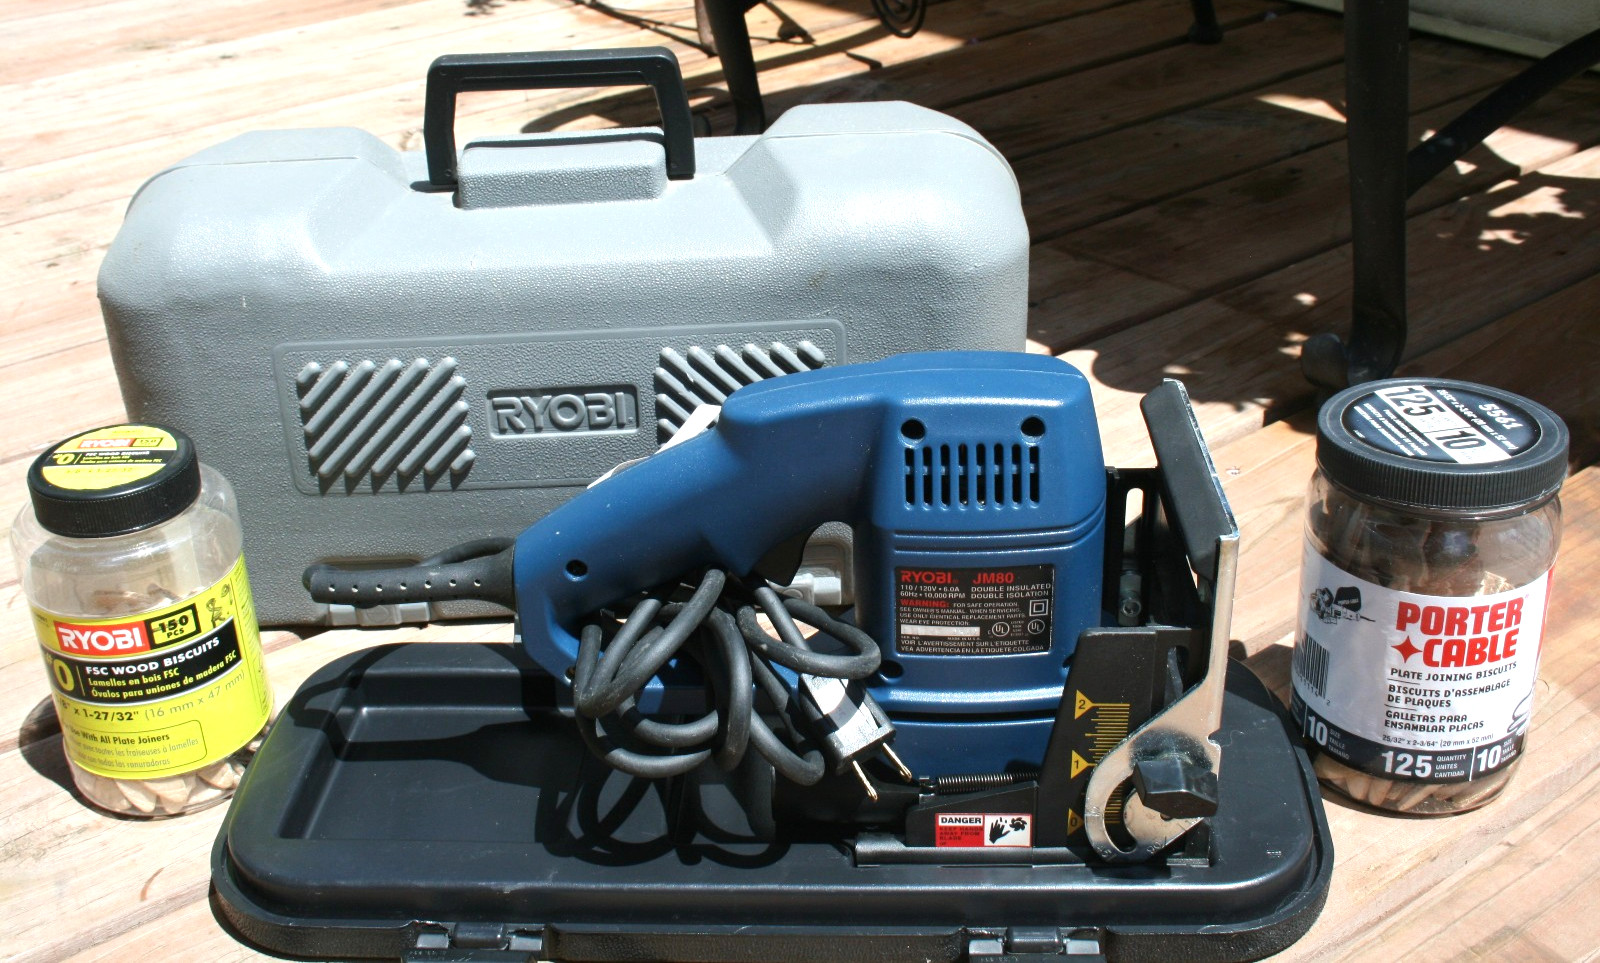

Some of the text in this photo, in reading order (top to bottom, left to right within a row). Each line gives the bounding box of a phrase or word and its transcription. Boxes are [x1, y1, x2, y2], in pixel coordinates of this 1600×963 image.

[1384, 388, 1446, 416] 125
[492, 392, 627, 433] RYOBI
[1478, 404, 1523, 429] 5561
[1435, 431, 1486, 449] 10
[900, 571, 1014, 584] RYOBI JM80
[1006, 583, 1052, 592] INSULATED
[1006, 590, 1049, 598] ISOLATION
[900, 599, 950, 608] WARNING:
[159, 614, 189, 633] 150
[1396, 597, 1524, 636] PORTER
[58, 627, 143, 651] RYOBI
[166, 628, 185, 638] PCS
[85, 636, 220, 676] FSC WOOD BISCUITS
[1422, 628, 1520, 668] CABLE
[88, 668, 180, 687] Lamelles en bois FSC
[92, 650, 237, 700] Óvalos para uniones de madera FSC
[1390, 661, 1517, 682] PLATE JOINING BISCUITS
[83, 708, 138, 722] 1-27/32"
[144, 707, 164, 720] (16
[170, 701, 194, 714] mm
[208, 686, 220, 699] 47
[224, 671, 245, 691] mm)
[1388, 679, 1510, 698] BISCUITS D'ASSEMBLAGE
[1078, 700, 1086, 710] 2
[1387, 694, 1452, 708] DE PLAQUES
[1386, 710, 1468, 723] GALLETAS PARA
[1308, 716, 1328, 746] 10
[1384, 719, 1484, 733] ENSAMBLAR PLACAS
[81, 732, 98, 742] With
[100, 736, 110, 744] All
[112, 736, 135, 744] Plate
[138, 733, 170, 744] Joiners
[115, 748, 125, 756] les
[169, 738, 199, 752] lamelles
[115, 760, 126, 768] las
[126, 758, 170, 768] ranuradoras
[1074, 760, 1080, 770] 1
[1382, 750, 1433, 778] 125
[1436, 754, 1467, 762] QUANTITY
[1477, 744, 1502, 772] 10
[1434, 770, 1464, 778] CANTIDAD
[940, 816, 982, 824] DANGER
[1070, 818, 1078, 828] 0
